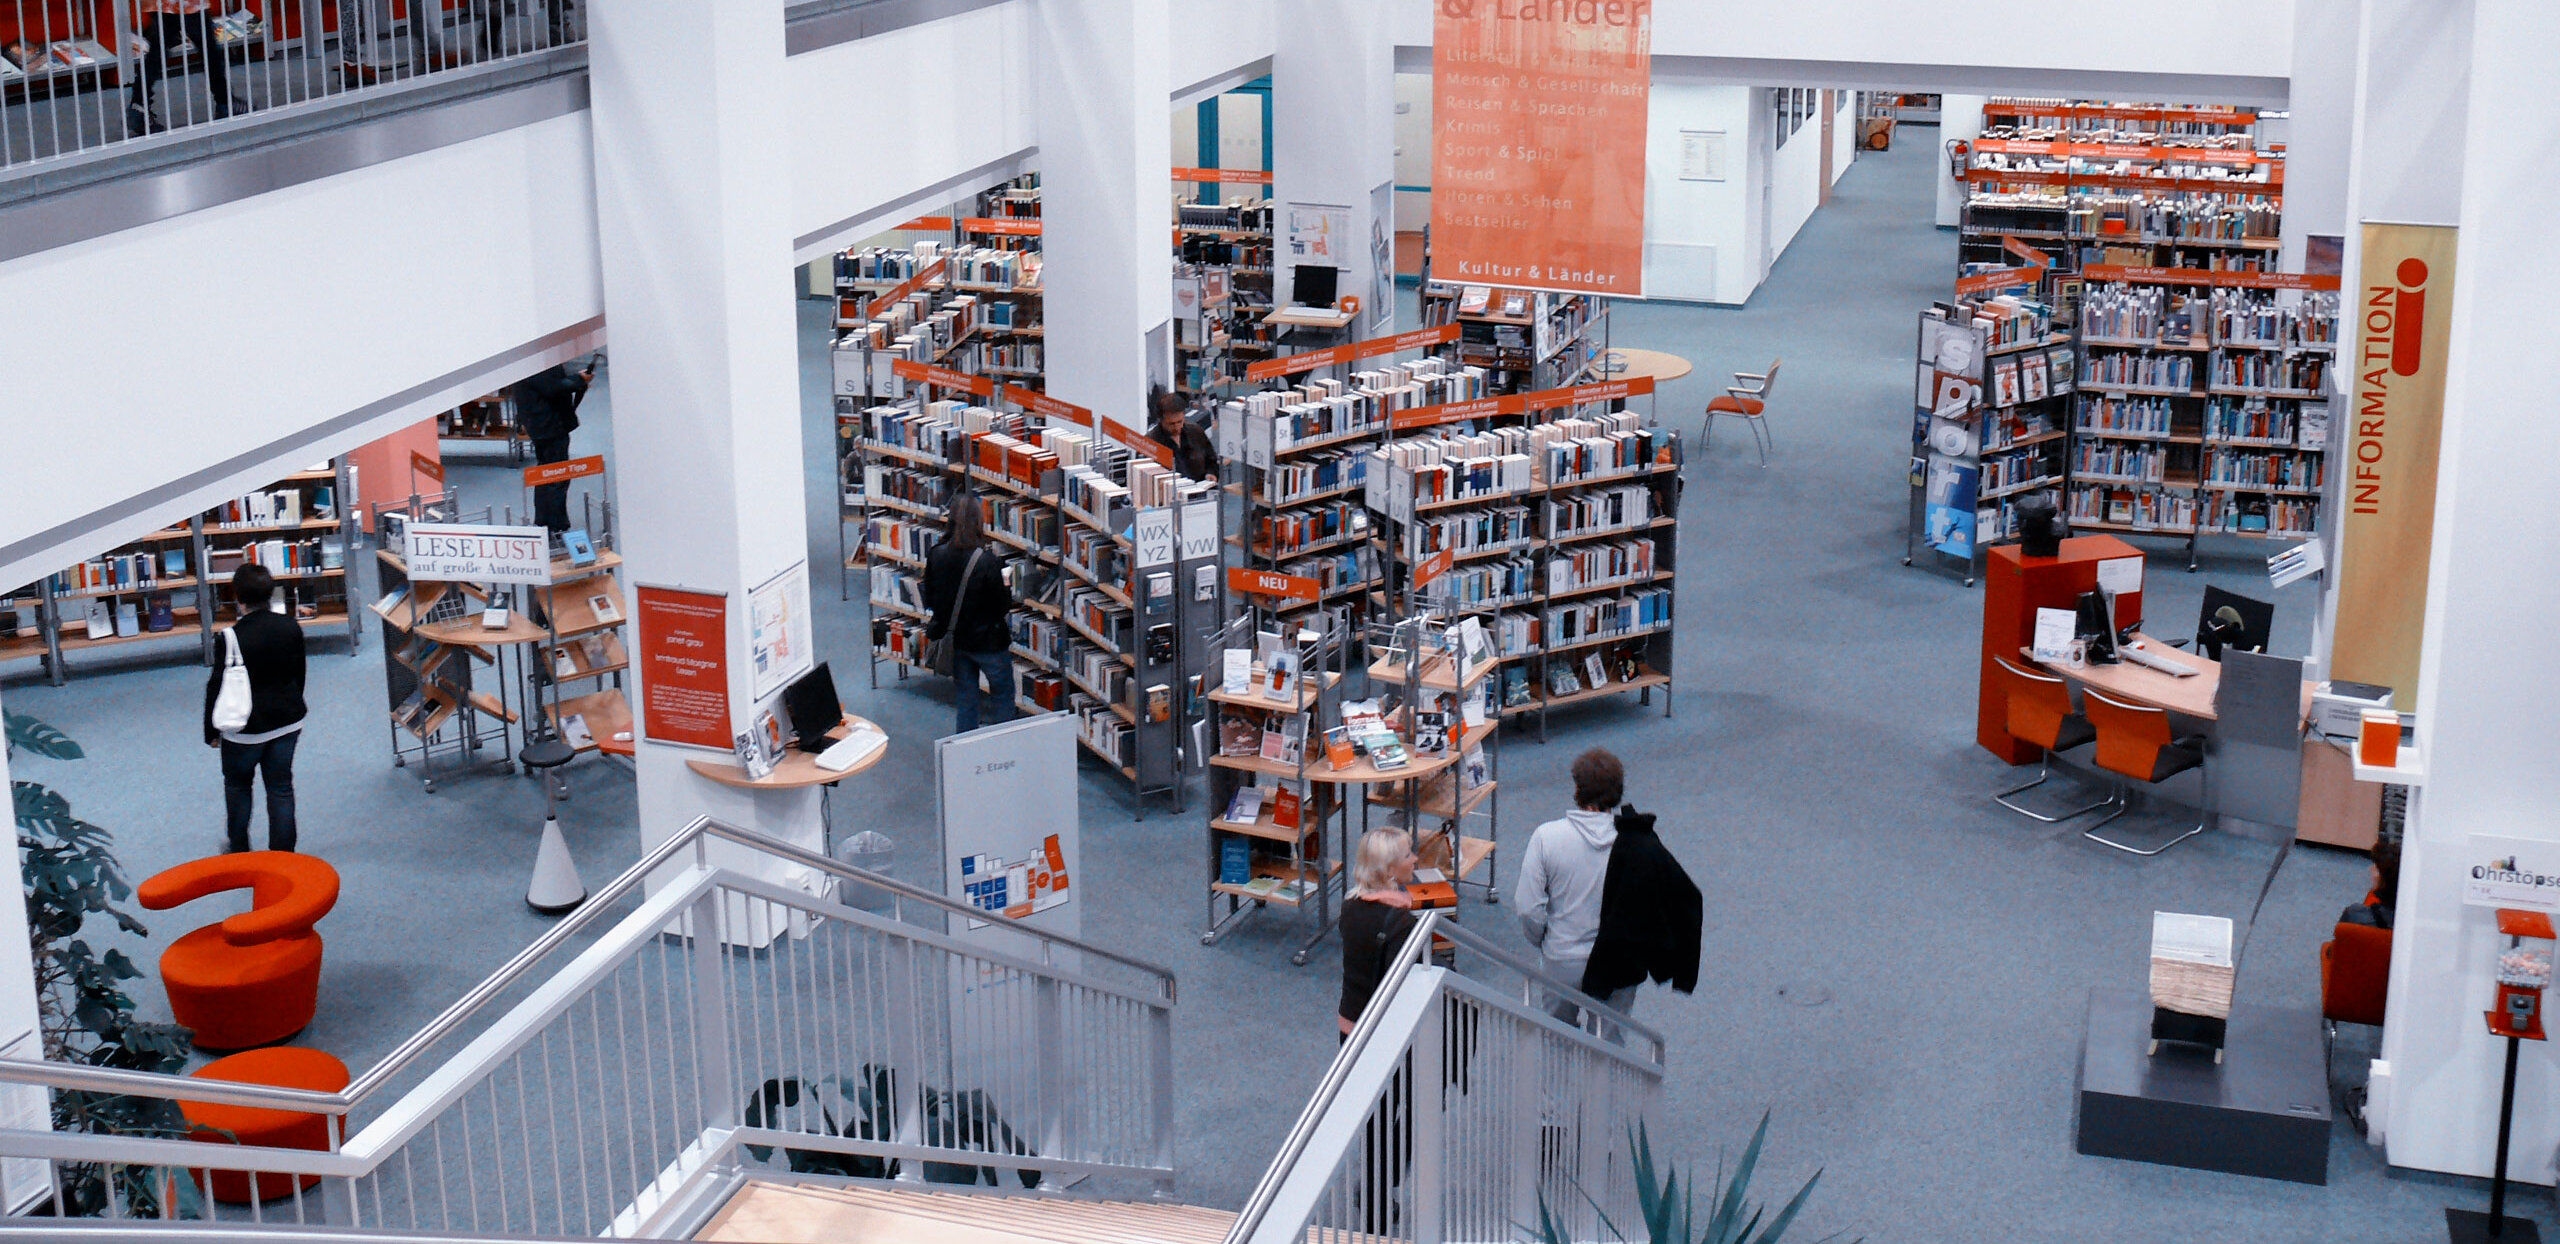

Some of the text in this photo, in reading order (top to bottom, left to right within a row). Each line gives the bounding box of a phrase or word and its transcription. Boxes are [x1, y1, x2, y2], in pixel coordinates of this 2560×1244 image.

[1442, 0, 1474, 19] &
[1446, 72, 1644, 98] Mensch & Gesellschaft
[1446, 95, 1609, 118] Reisen & Sprachen
[1446, 119, 1500, 135] Krimis
[1445, 142, 1559, 162] Sport & Spiel
[1445, 166, 1496, 181] Trend
[1504, 193, 1514, 206] &
[1521, 193, 1572, 210] Sehen
[1445, 212, 1528, 230] Bestseller
[1458, 260, 1616, 285] Kultur & Länder
[845, 379, 855, 392] S
[884, 381, 894, 394] S
[2353, 287, 2394, 514] INFORMATION
[1227, 441, 1235, 455] S
[542, 463, 588, 478] Unser Tipp
[1141, 523, 1169, 542] WX
[413, 537, 542, 560] LESELUST
[1144, 545, 1167, 562] YZ
[1186, 537, 1215, 555] VW
[414, 561, 542, 577] auf große Autoren
[1259, 575, 1288, 591] NEU
[987, 760, 1015, 772] Etage
